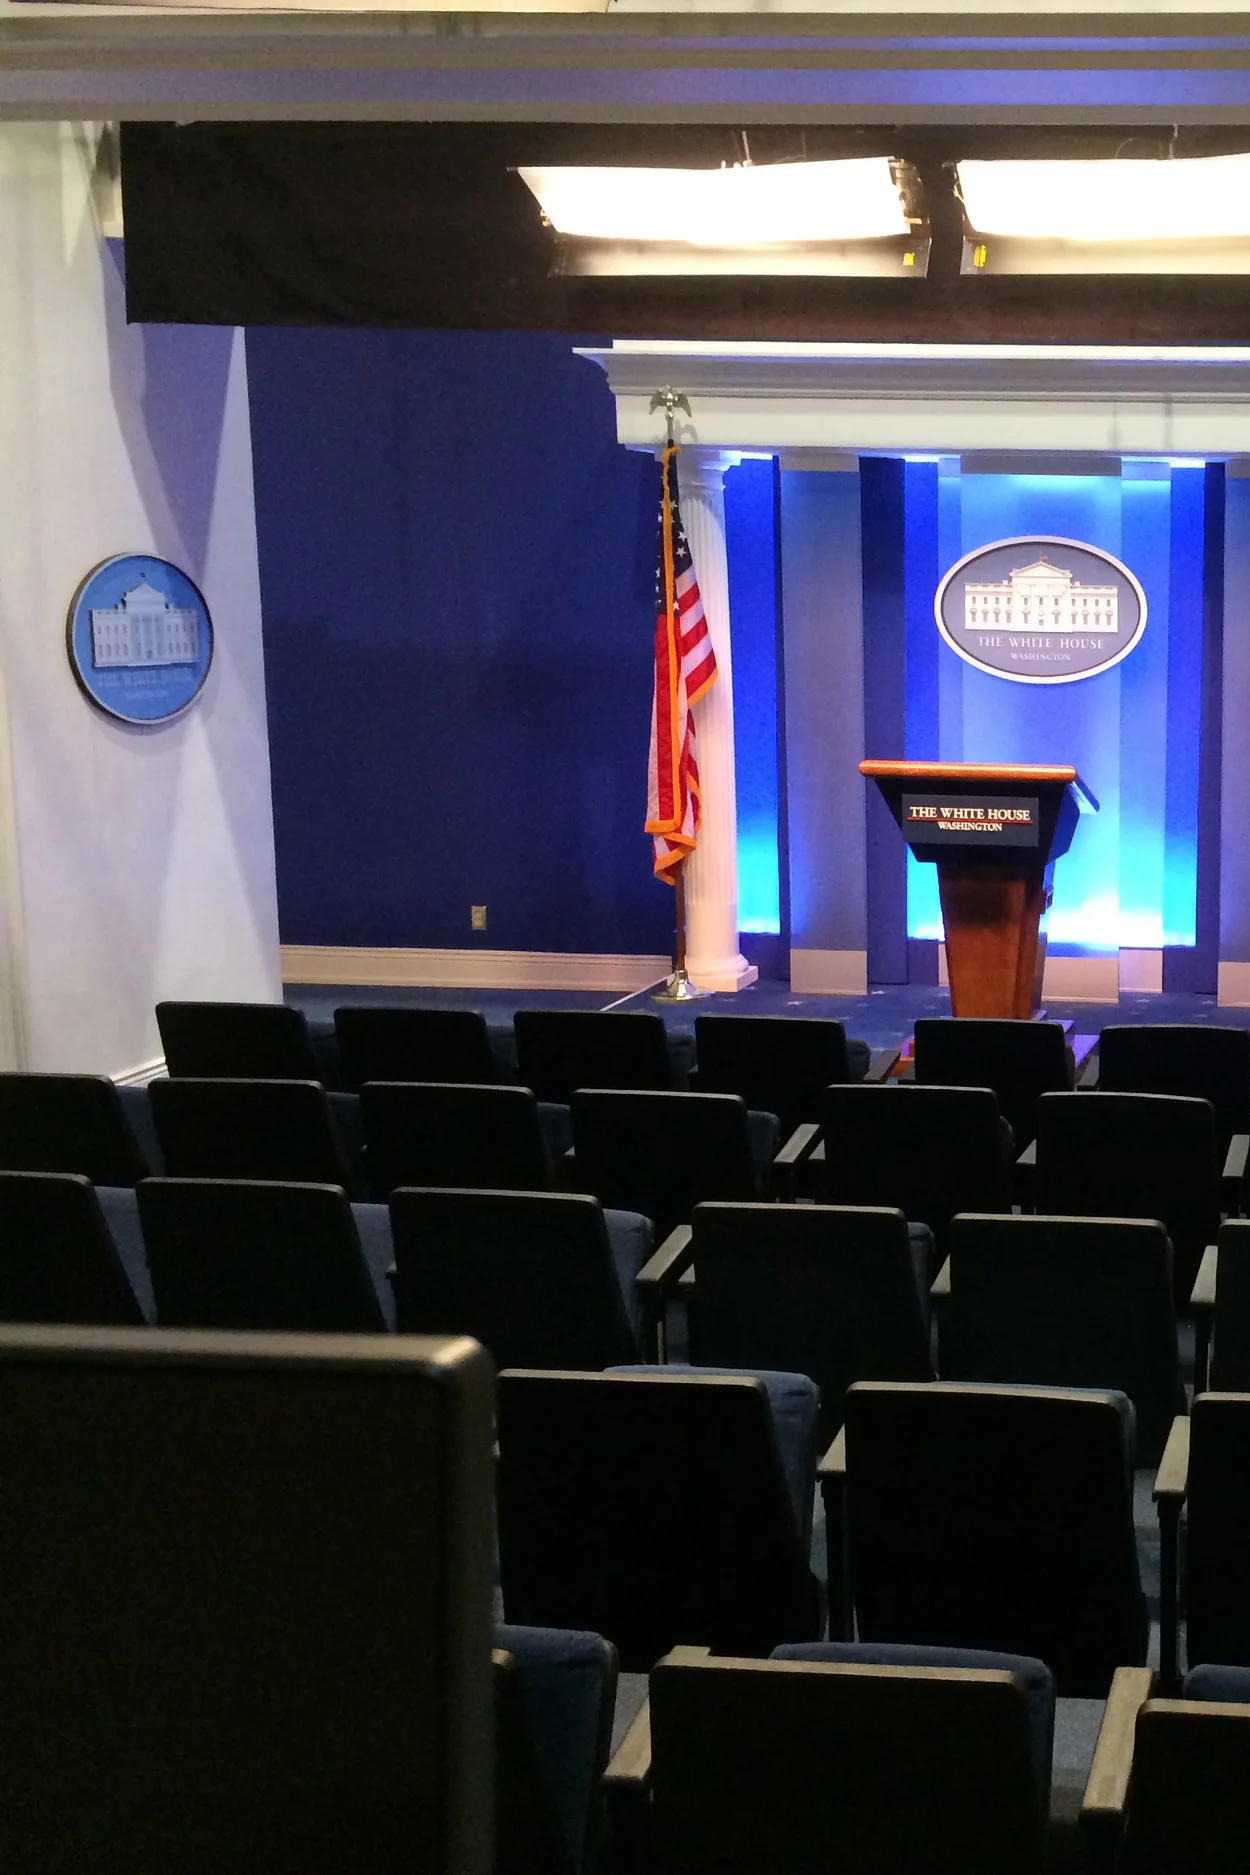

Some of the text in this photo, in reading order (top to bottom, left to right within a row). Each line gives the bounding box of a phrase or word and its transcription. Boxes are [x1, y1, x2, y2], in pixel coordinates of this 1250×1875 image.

[977, 636, 1105, 649] THE WHITE HOUSE
[1010, 652, 1071, 661] WASHINGTON
[909, 806, 1031, 821] THE WHITE HOUSE
[937, 821, 1003, 832] WASHINGTON
